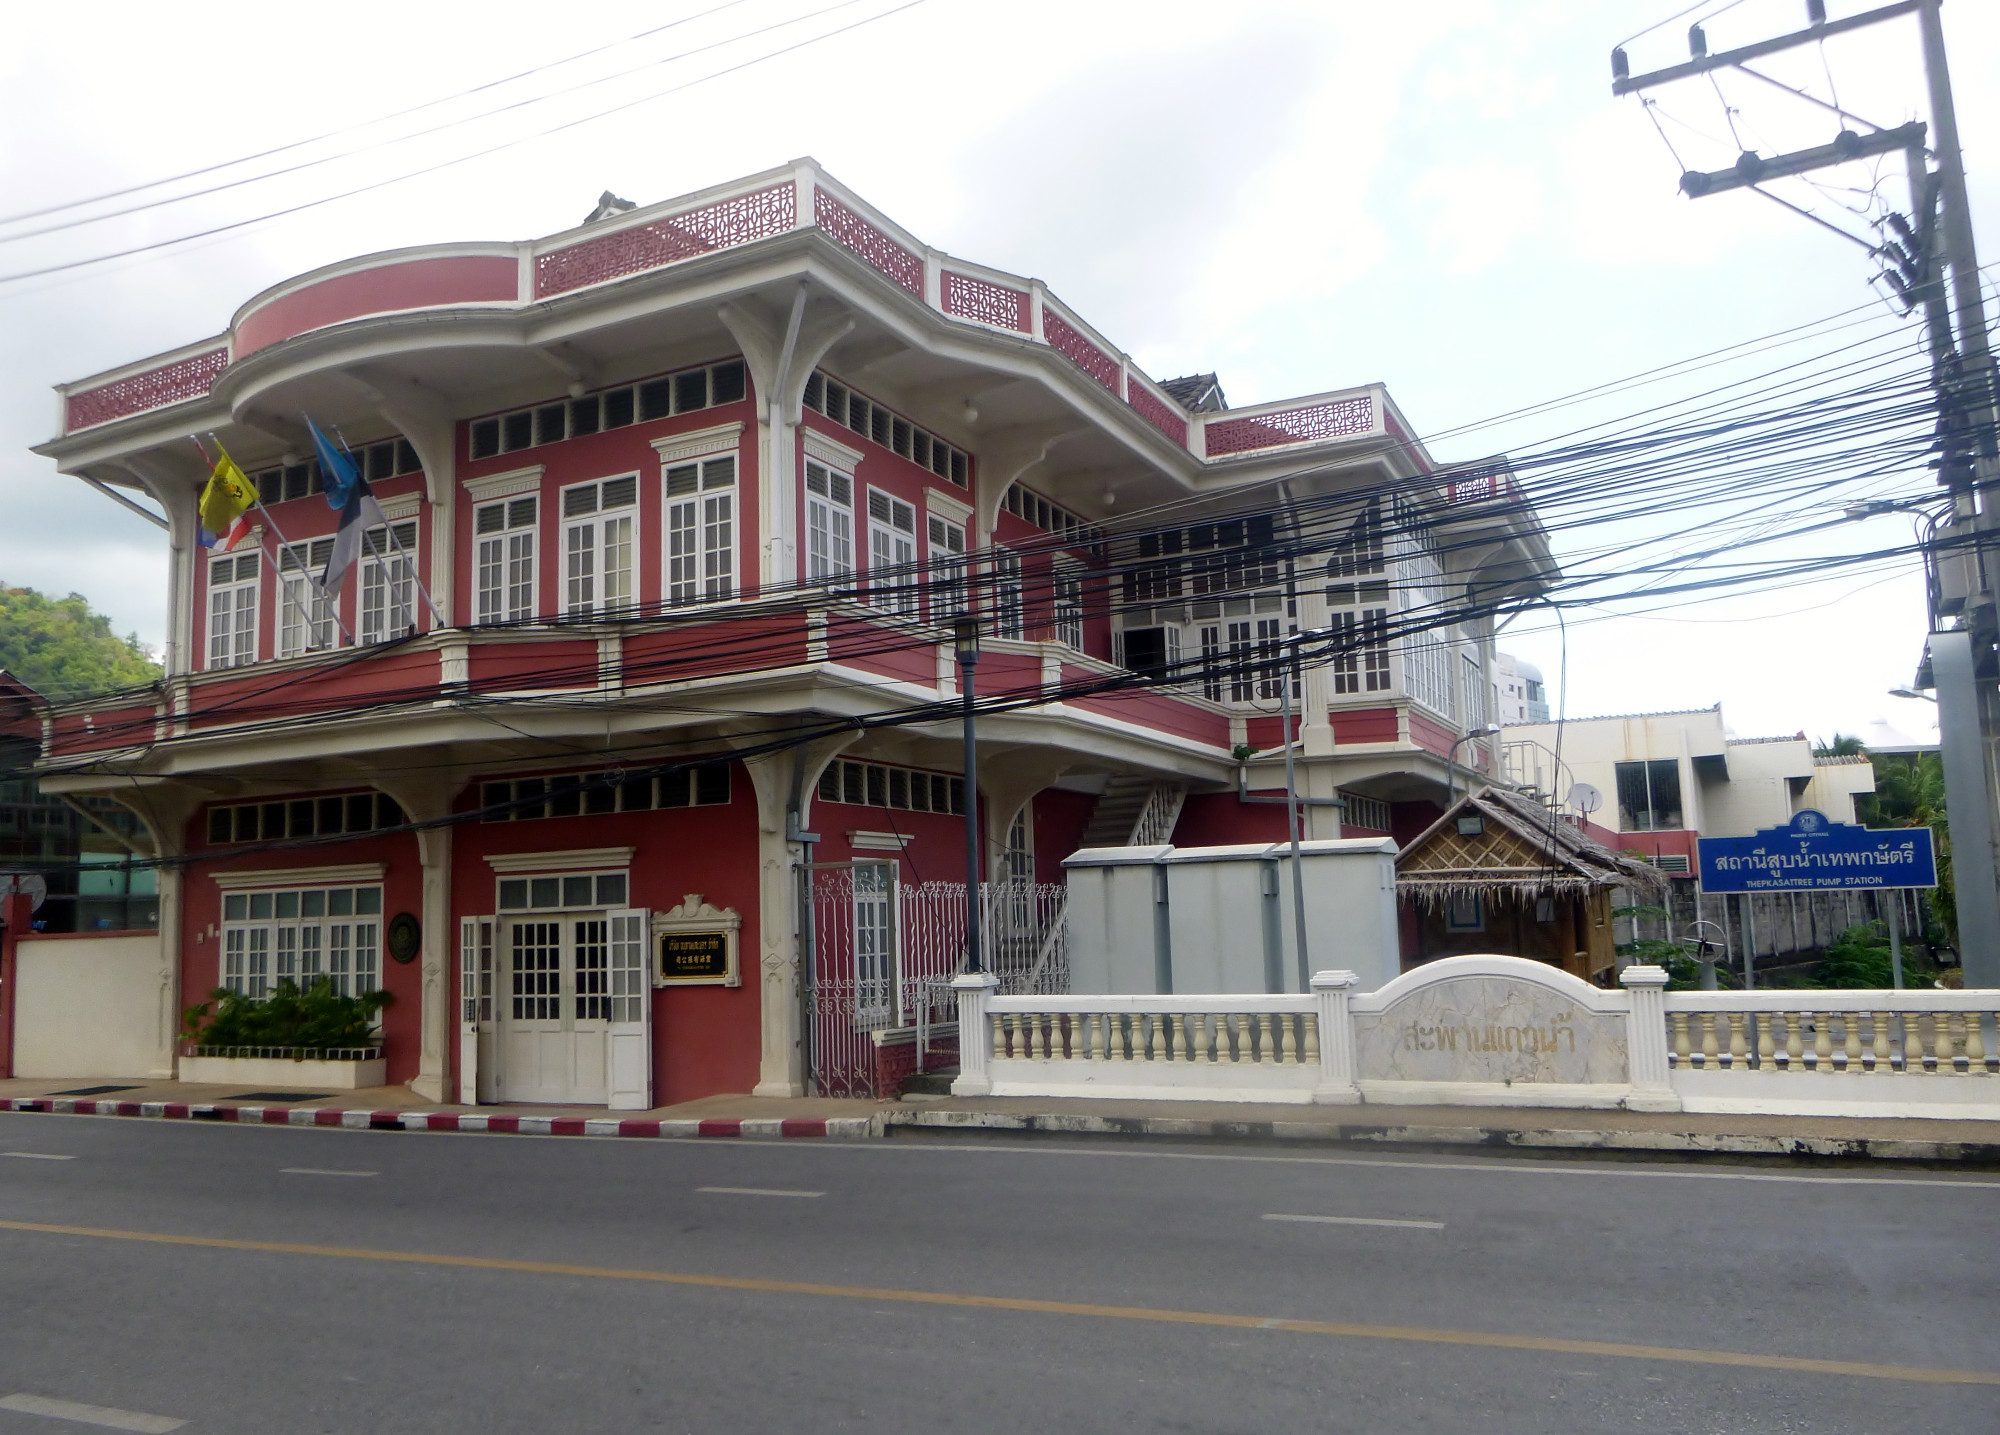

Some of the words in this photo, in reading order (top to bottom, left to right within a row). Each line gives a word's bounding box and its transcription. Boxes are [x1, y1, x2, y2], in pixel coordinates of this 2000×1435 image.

[1715, 841, 1914, 877] สถานีสูบน้ำเทพกษัตรี
[1746, 877, 1813, 888] THEPKASATTREE
[1816, 877, 1842, 886] PUMP
[1845, 876, 1883, 885] STATION
